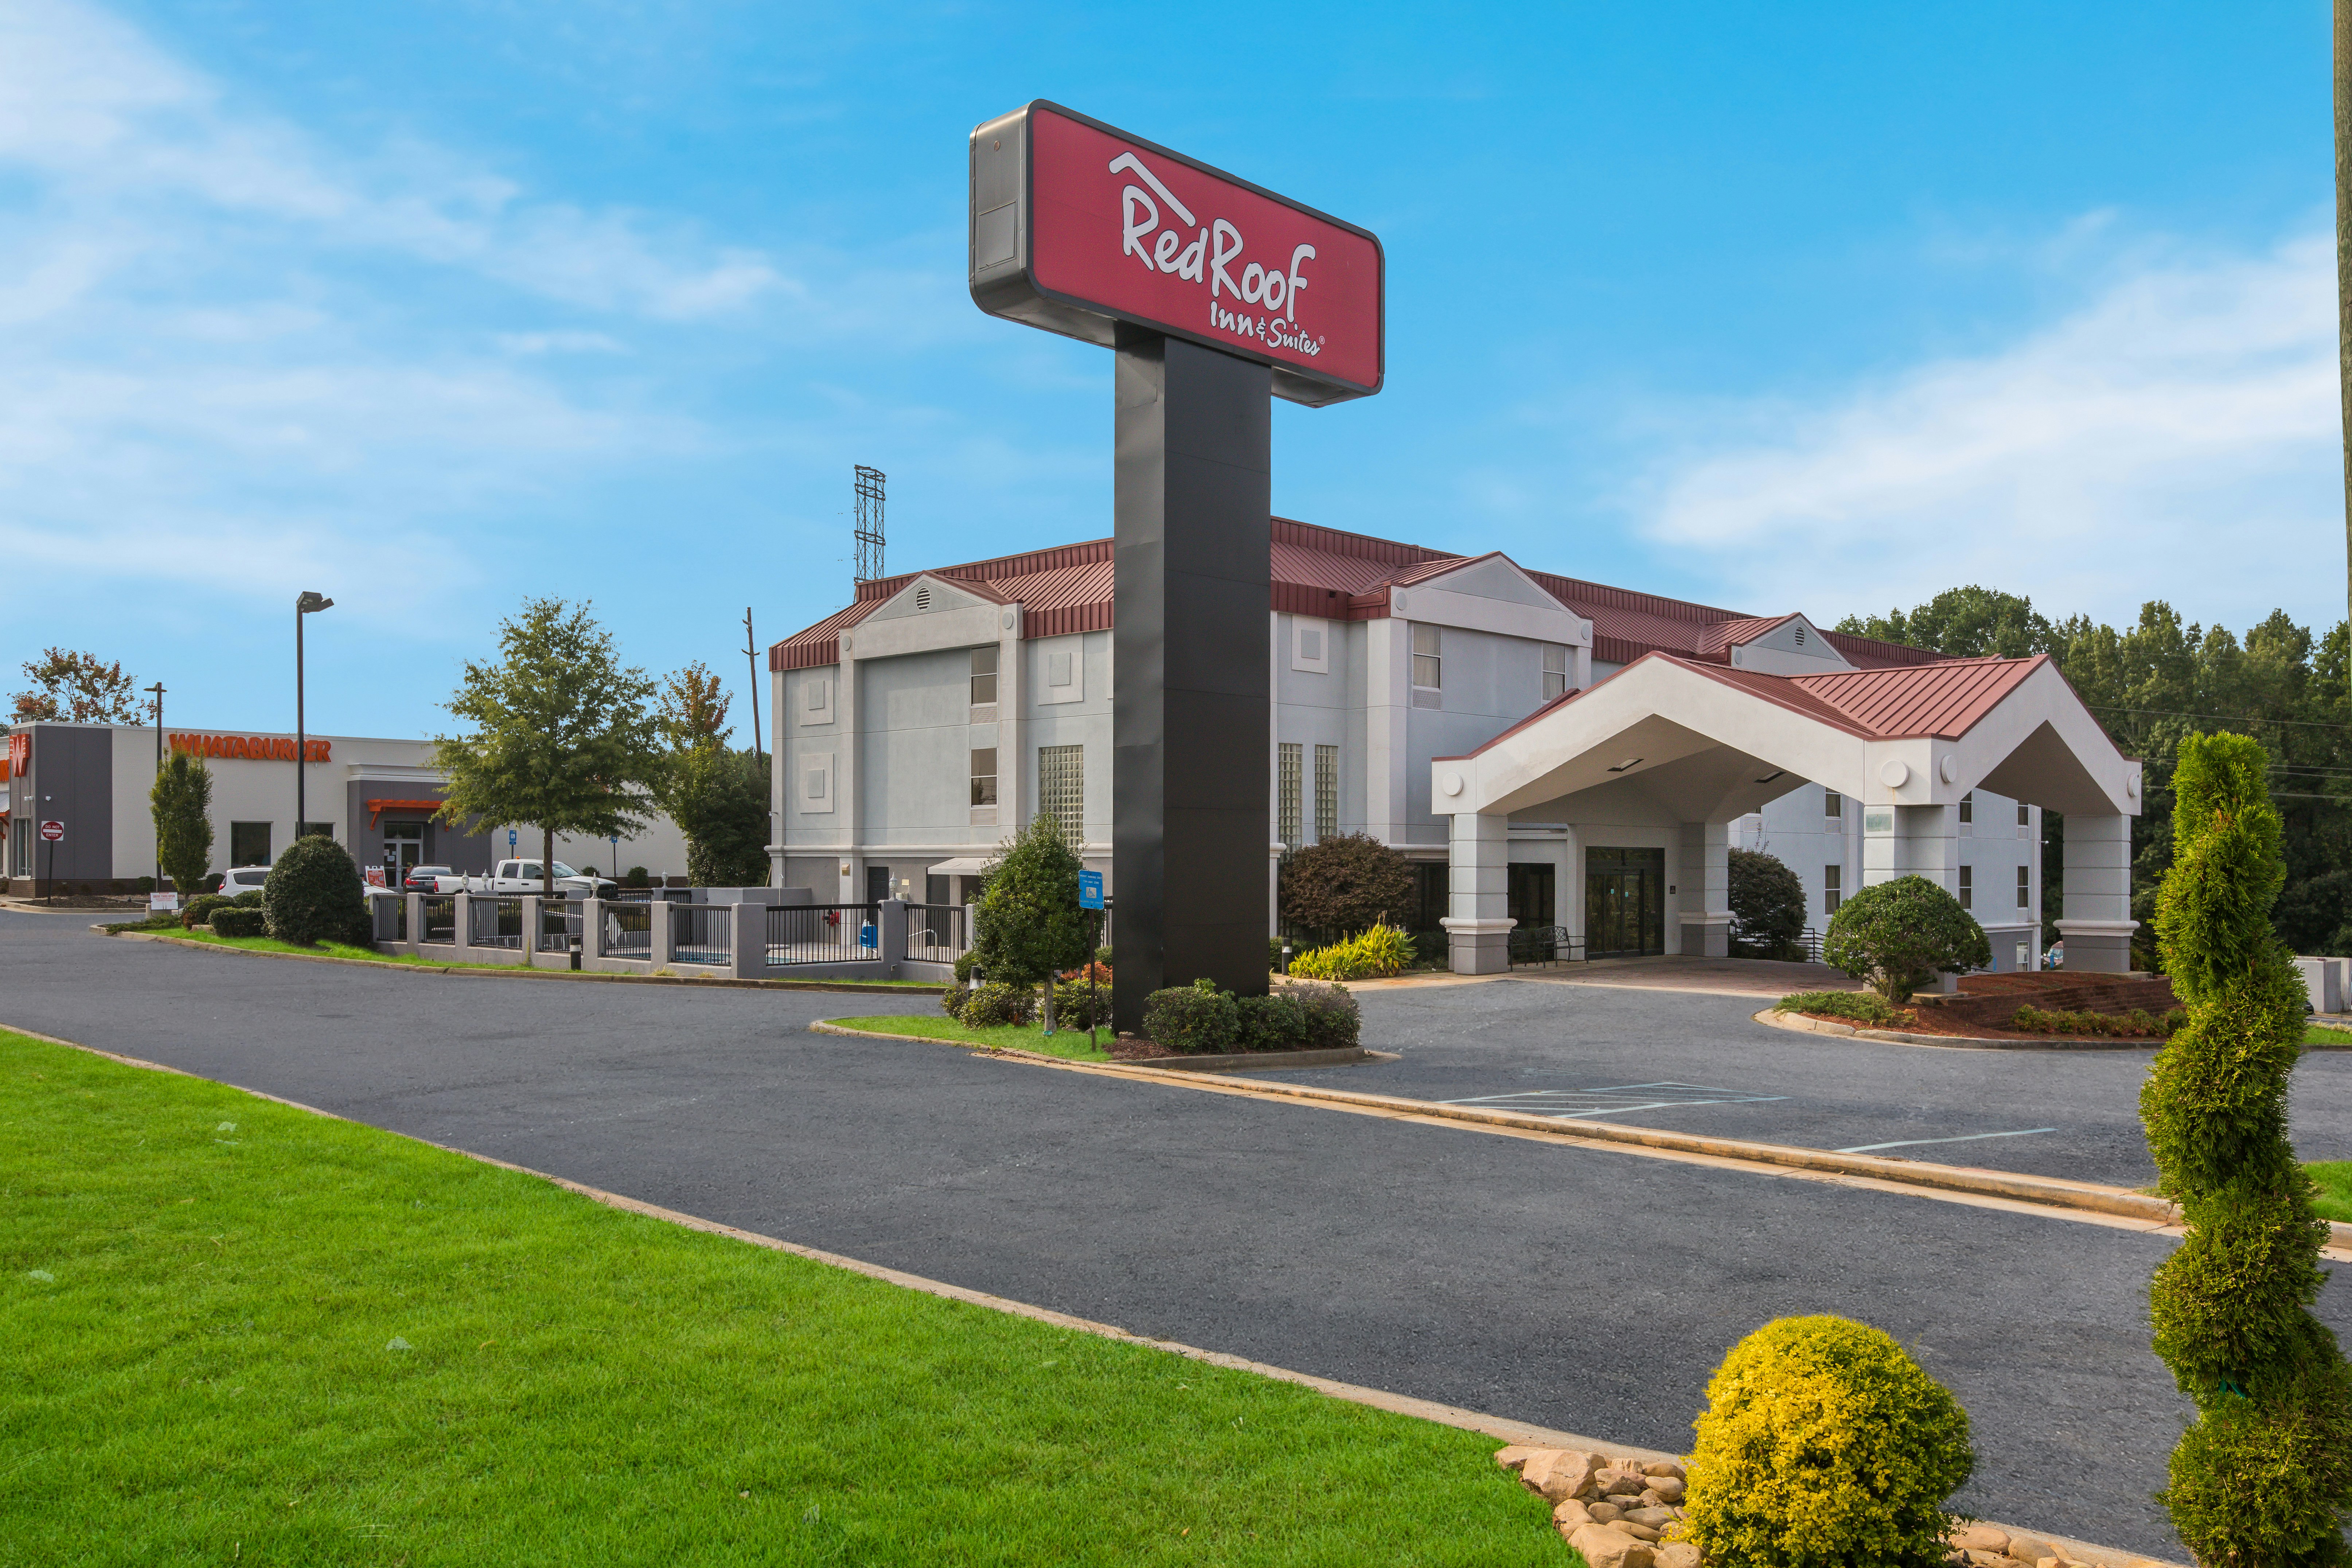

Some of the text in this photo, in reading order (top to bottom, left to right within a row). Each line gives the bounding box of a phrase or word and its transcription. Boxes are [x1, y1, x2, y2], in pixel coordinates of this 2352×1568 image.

[1210, 301, 1254, 337] Inn
[1256, 316, 1266, 341] &
[168, 733, 331, 762] WHATABURGER
